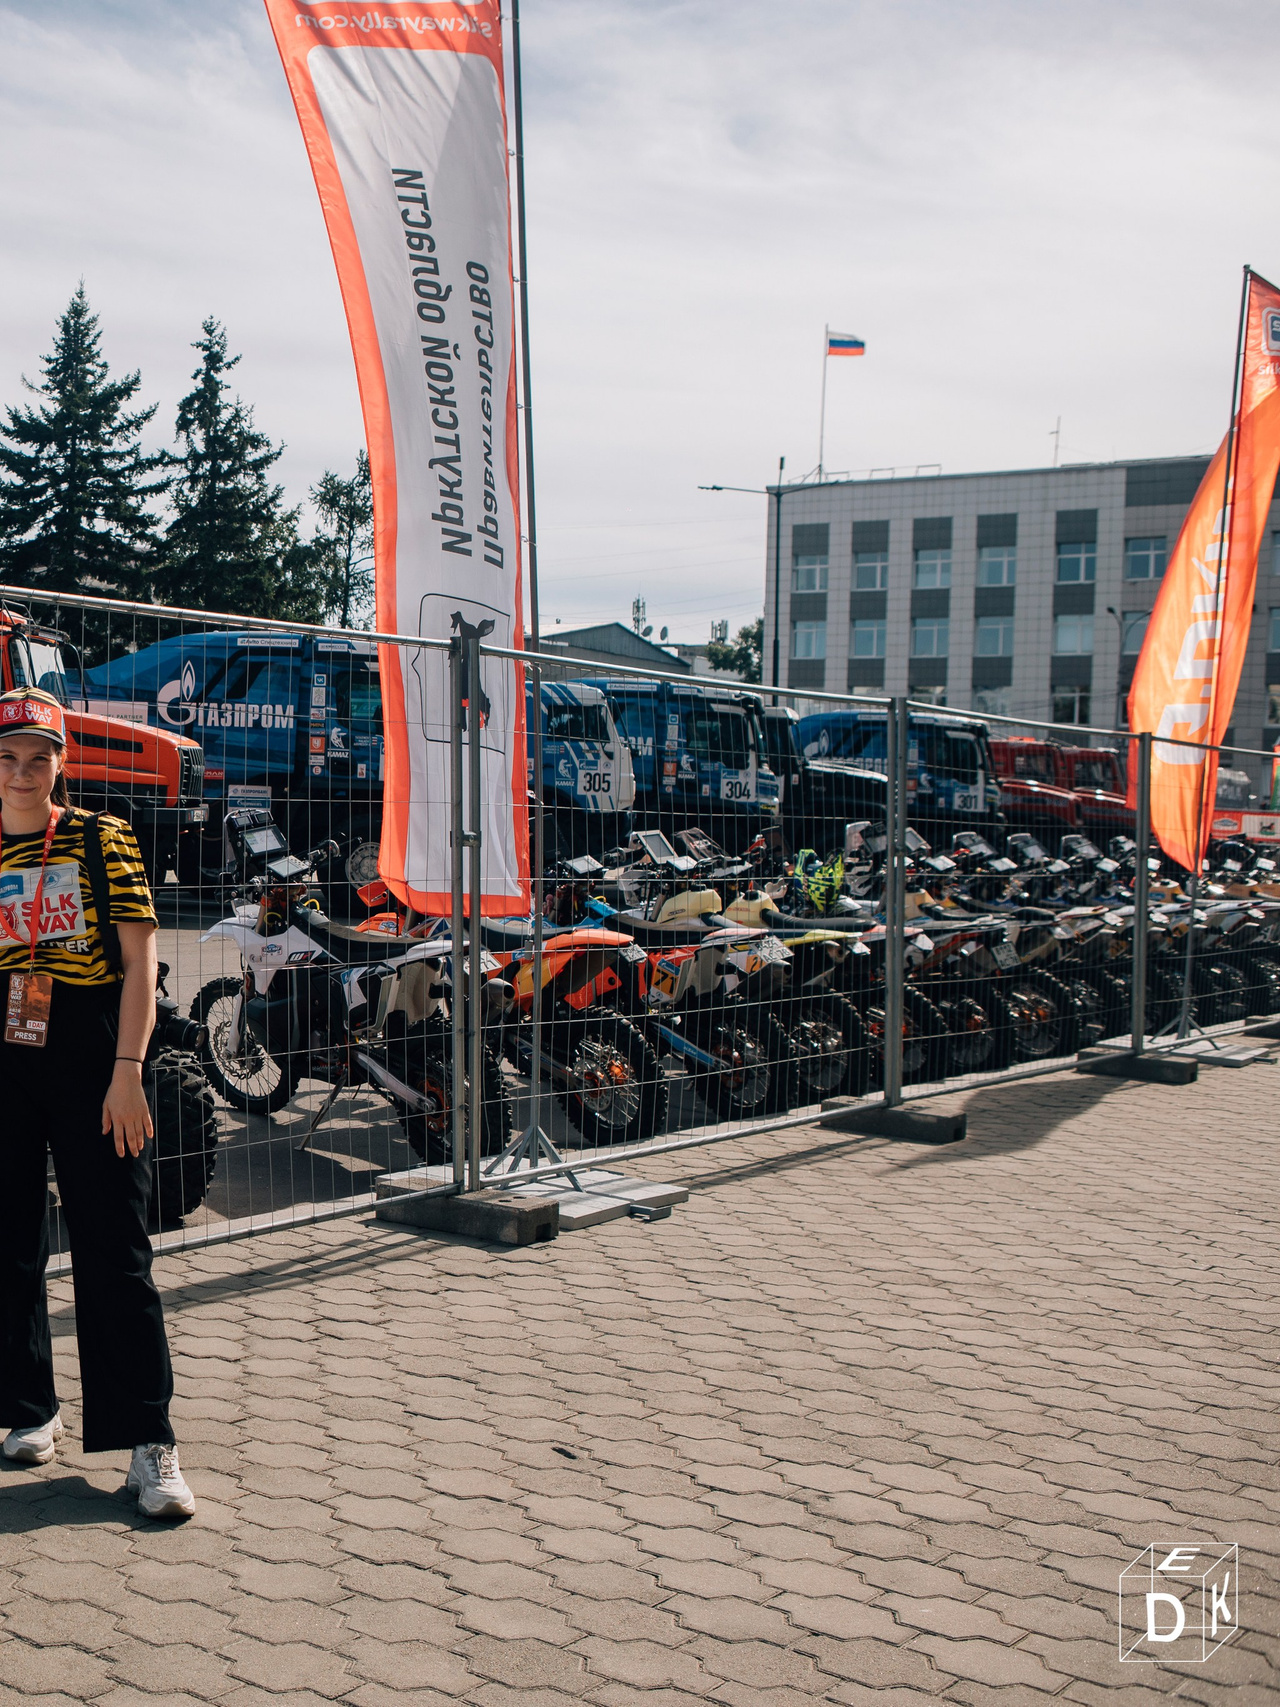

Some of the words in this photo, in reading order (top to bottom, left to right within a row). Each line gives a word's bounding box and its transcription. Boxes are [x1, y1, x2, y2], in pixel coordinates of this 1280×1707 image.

[24, 702, 53, 717] SILK
[25, 711, 53, 725] WAY
[197, 702, 295, 729] ГАЗПРОМ
[583, 772, 612, 793] 305
[725, 781, 752, 800] 304
[958, 794, 979, 810] 301
[654, 968, 677, 995] 71
[14, 1031, 37, 1041] PRESS
